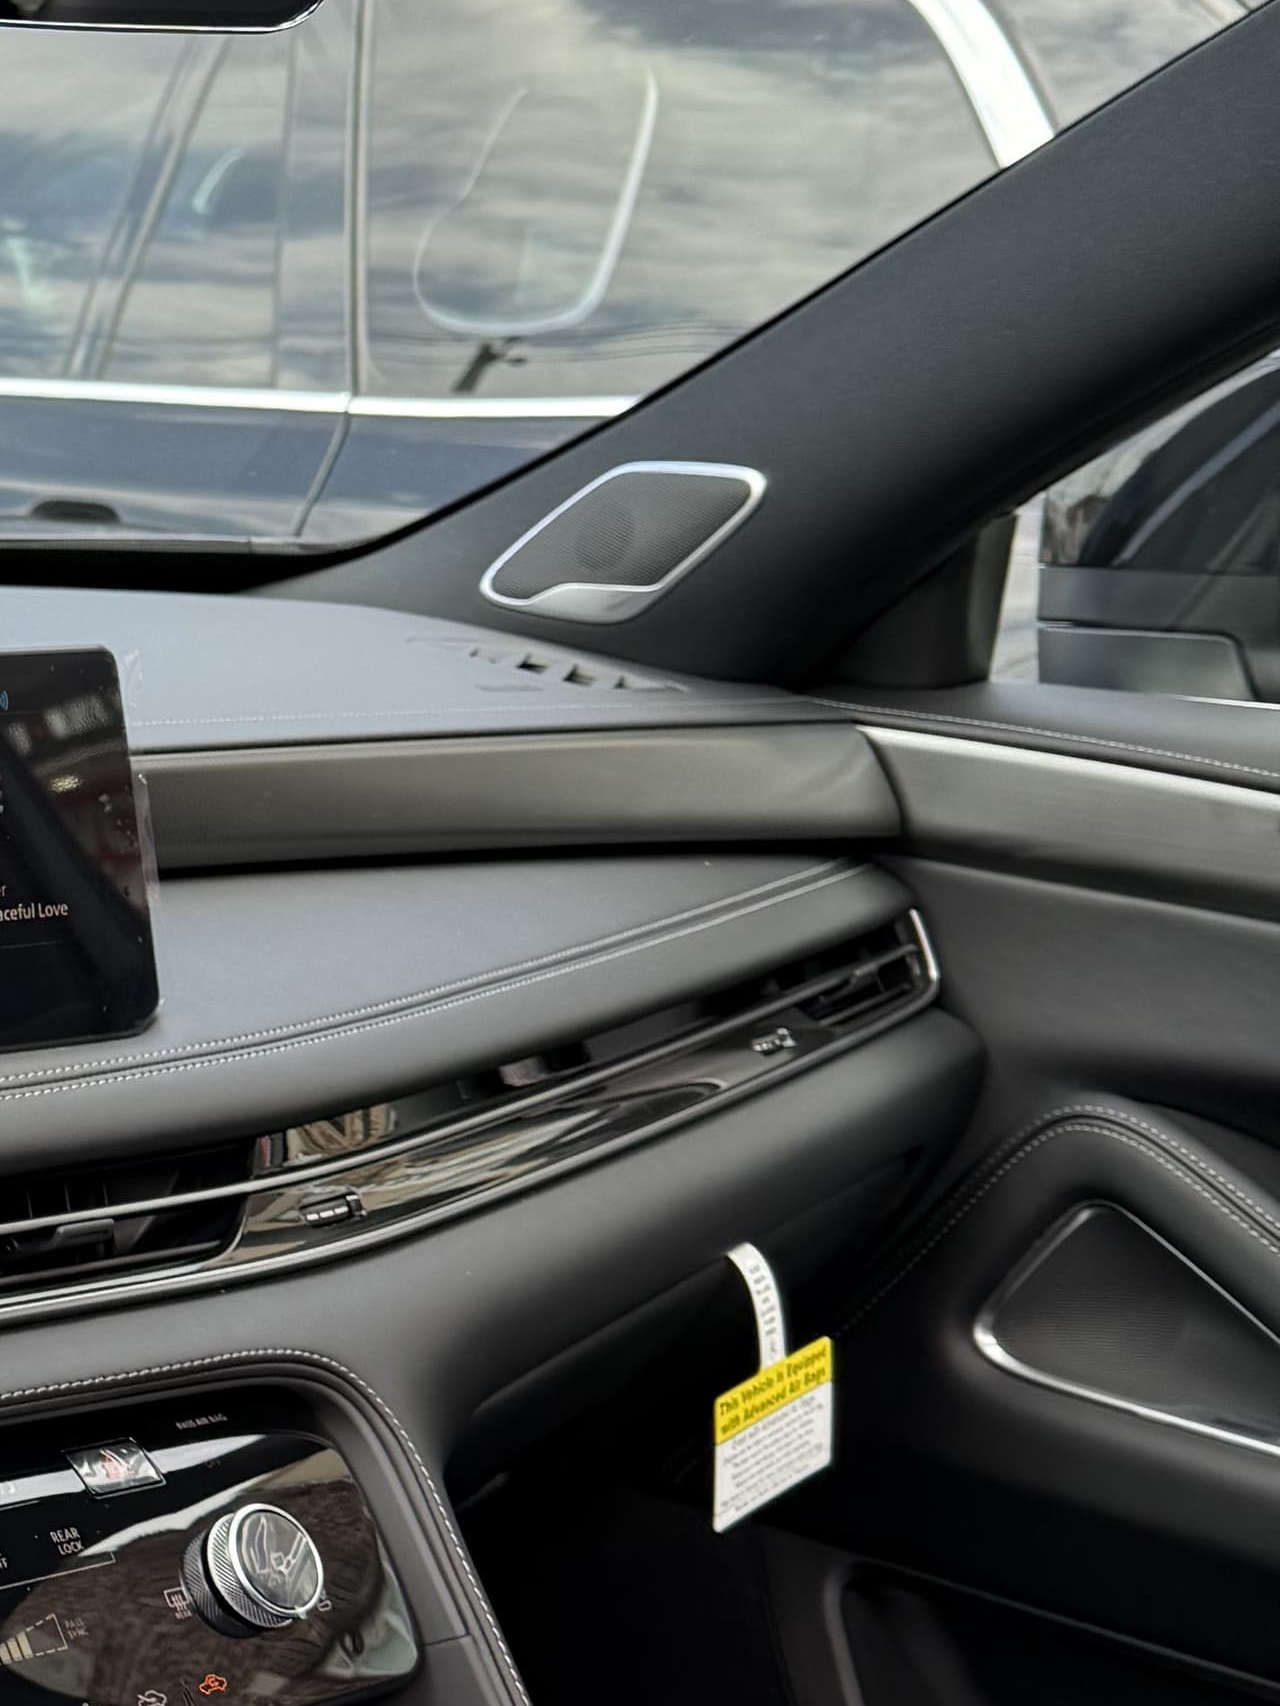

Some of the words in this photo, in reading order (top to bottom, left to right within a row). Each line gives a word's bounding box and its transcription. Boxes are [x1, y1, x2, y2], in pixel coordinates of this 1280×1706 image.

[39, 902, 68, 918] Love
[51, 1527, 80, 1543] REAR
[58, 1541, 83, 1555] LOCK
